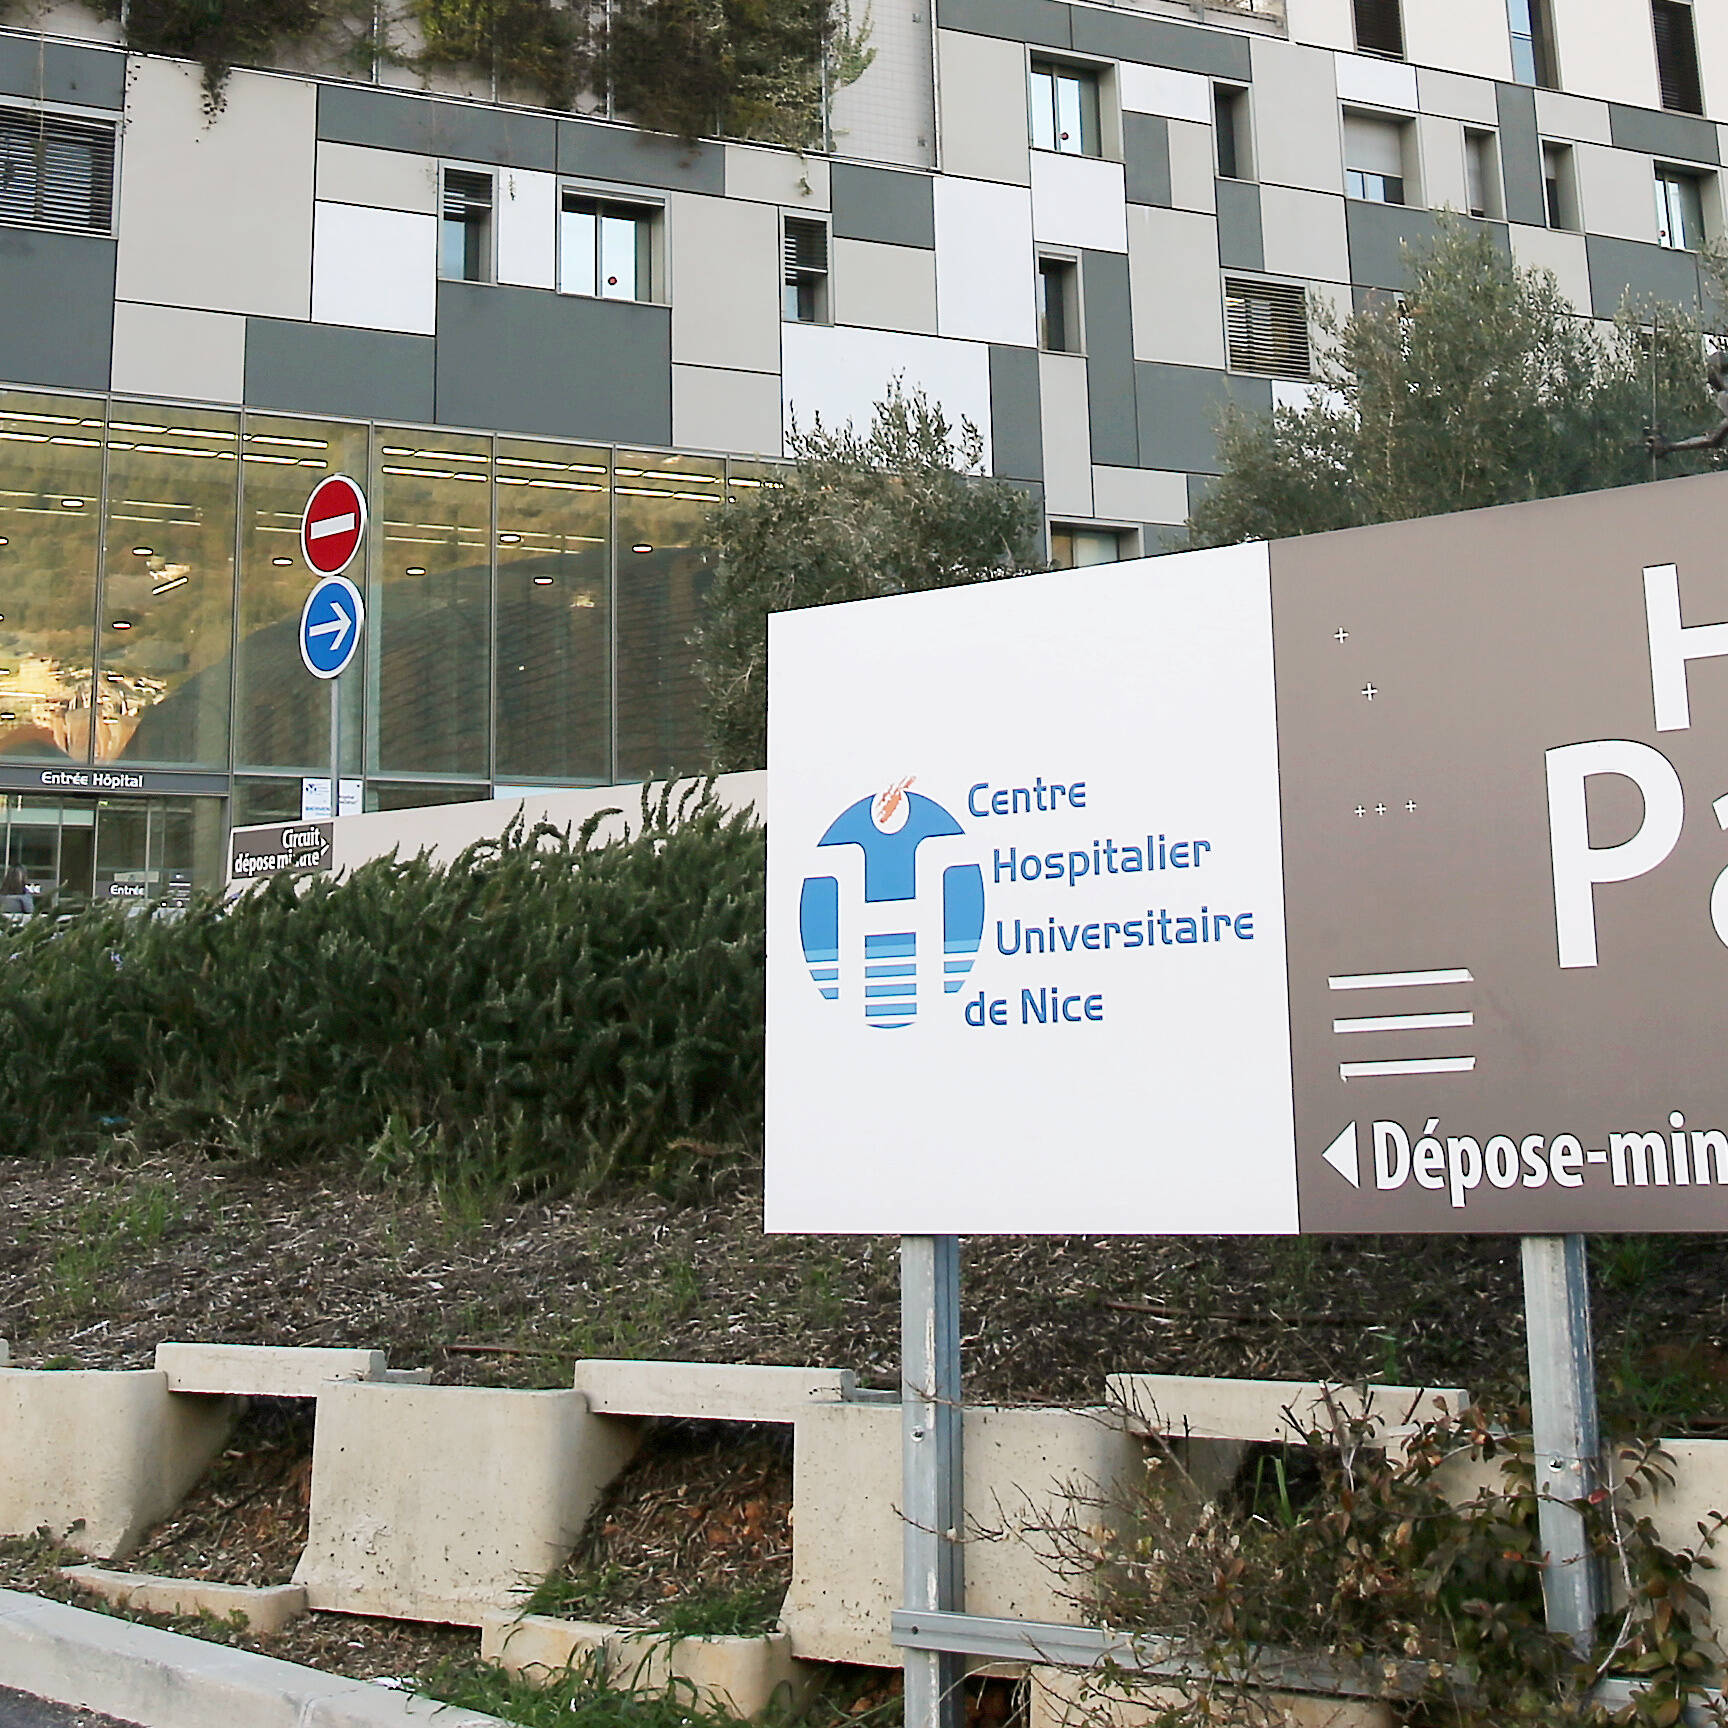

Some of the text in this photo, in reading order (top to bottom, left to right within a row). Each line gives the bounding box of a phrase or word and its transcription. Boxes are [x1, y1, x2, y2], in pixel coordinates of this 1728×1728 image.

[41, 771, 144, 789] Entrée Hôpital
[967, 776, 1087, 818] Centre
[282, 826, 320, 849] Circuit
[234, 853, 275, 876] dépose
[992, 833, 1212, 887] Hospitalier
[996, 905, 1255, 957] Universitaire
[964, 986, 1104, 1027] de Nice
